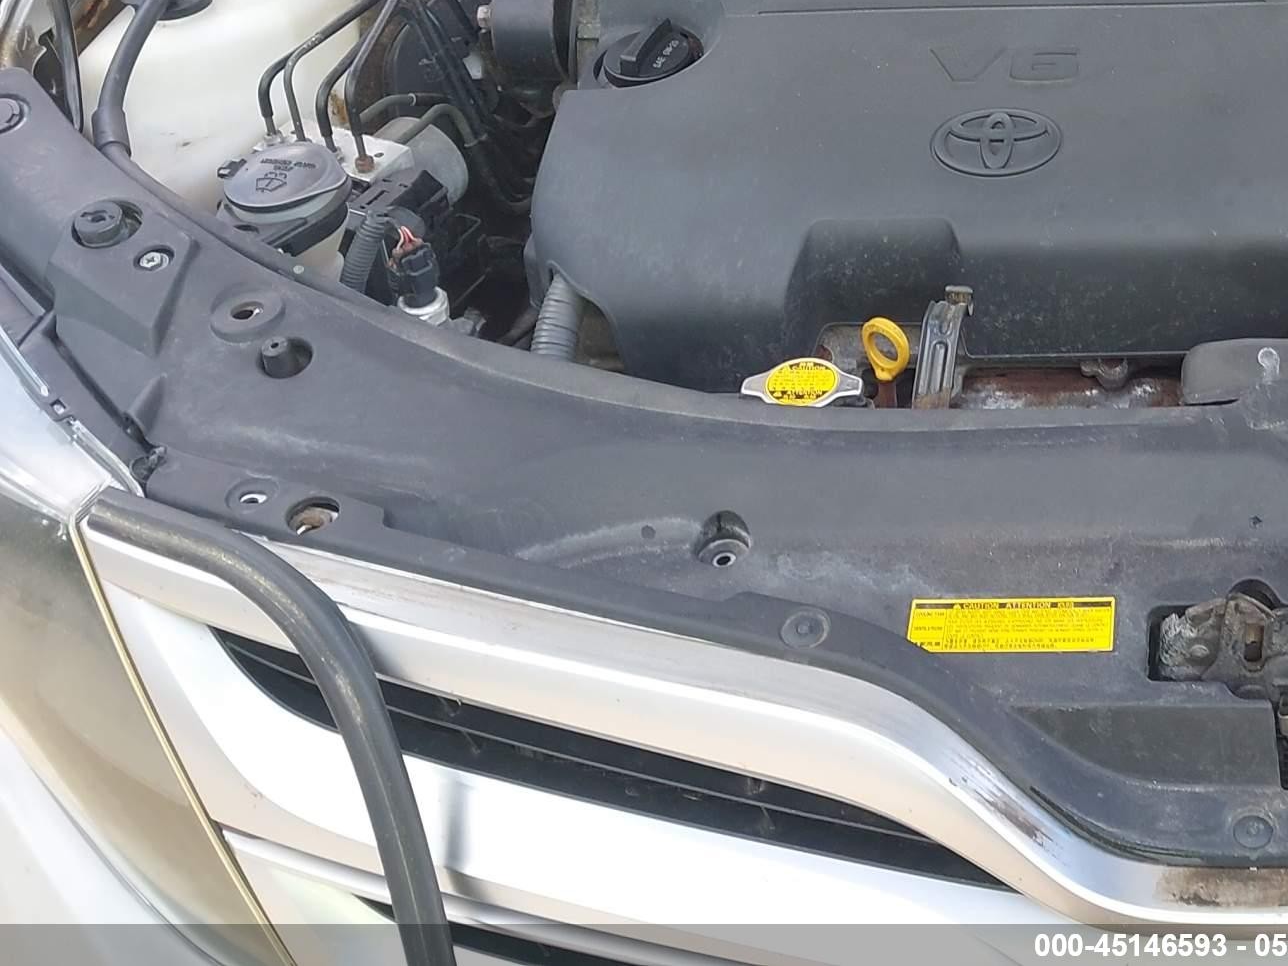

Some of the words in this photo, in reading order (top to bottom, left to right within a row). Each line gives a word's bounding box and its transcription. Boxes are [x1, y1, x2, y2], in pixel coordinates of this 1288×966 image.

[929, 47, 1081, 83] V6
[962, 602, 999, 610] CAUTION
[1005, 601, 1051, 609] ATTENTION
